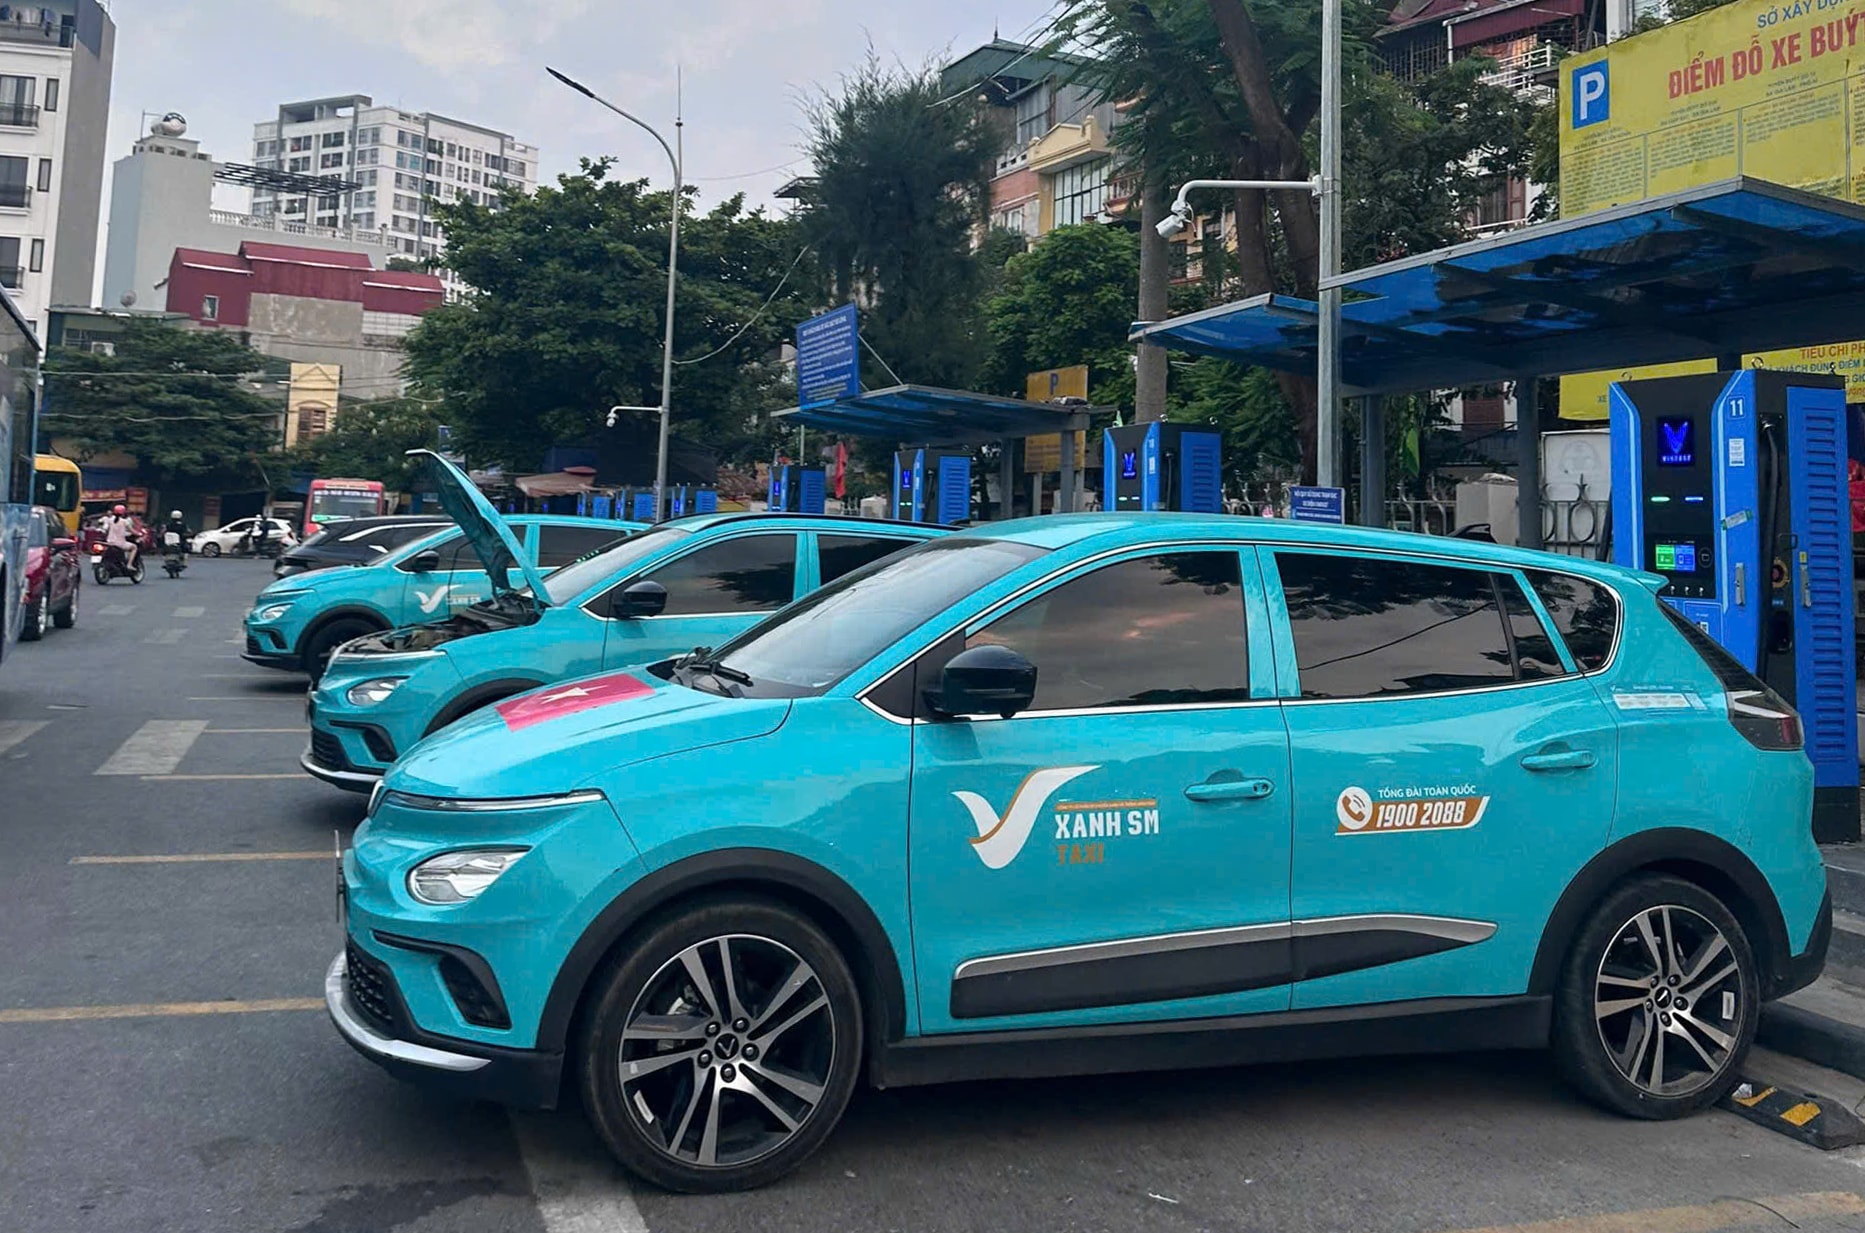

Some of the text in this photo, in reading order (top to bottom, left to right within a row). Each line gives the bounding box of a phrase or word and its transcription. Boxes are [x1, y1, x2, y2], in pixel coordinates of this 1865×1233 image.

[1757, 6, 1778, 28] SỞ
[1668, 51, 1724, 99] ĐIỂM
[1732, 34, 1763, 81] ĐỖ
[1771, 32, 1802, 70] XE
[1580, 71, 1605, 120] P
[1050, 373, 1059, 395] P
[1730, 398, 1744, 416] 11
[1406, 784, 1422, 797] ĐÀI
[1423, 784, 1449, 797] TOÀN
[1450, 783, 1477, 797] QUỐC
[1055, 810, 1160, 839] XANH SM
[1376, 801, 1467, 828] 1900 2088
[1057, 842, 1105, 865] TAXI
